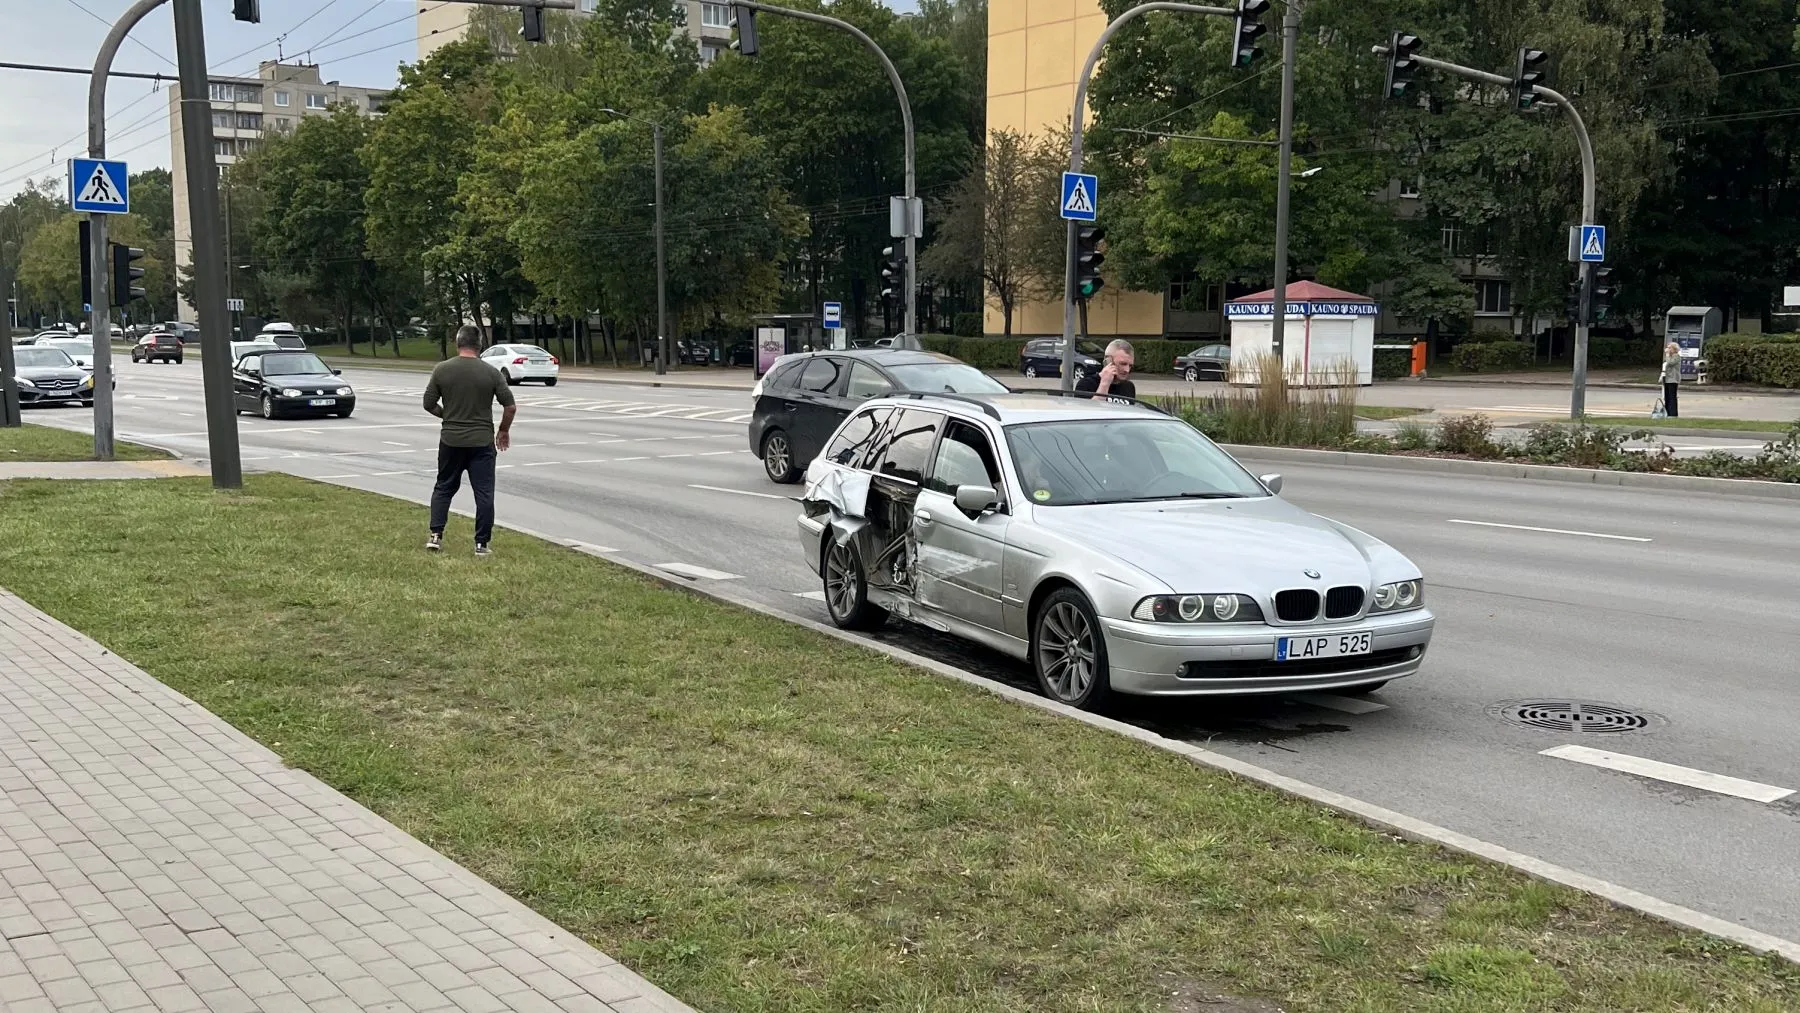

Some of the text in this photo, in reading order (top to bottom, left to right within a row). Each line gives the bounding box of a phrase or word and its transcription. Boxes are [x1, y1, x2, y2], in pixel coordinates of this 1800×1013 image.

[1229, 304, 1305, 314] KAUNO SUDA
[1311, 304, 1378, 314] KAUNO SPAUDA
[1289, 638, 1328, 658] LAP
[1339, 634, 1369, 654] 525
